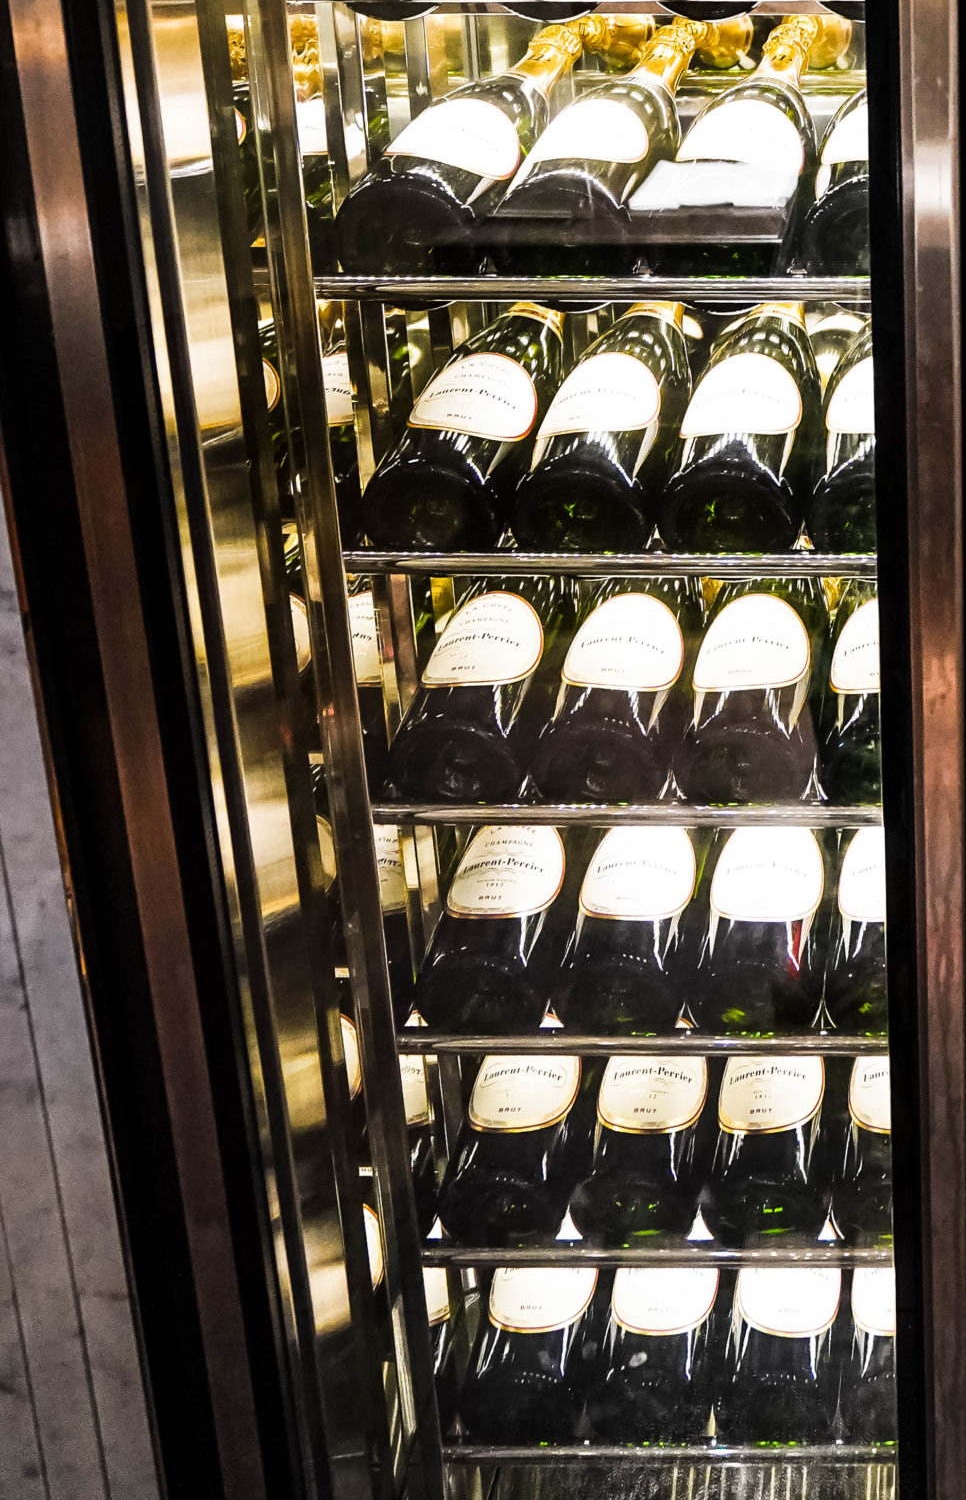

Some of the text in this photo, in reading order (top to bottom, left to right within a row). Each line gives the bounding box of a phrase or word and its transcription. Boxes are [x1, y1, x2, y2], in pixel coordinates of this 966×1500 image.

[438, 632, 521, 651] Laurent-Perrier
[484, 840, 534, 848] CHAMPAGNE
[463, 857, 544, 874] Laurent-Perrier
[484, 1065, 563, 1082] Laurent-Perrier
[613, 1066, 693, 1084] Laurent-Perrier
[729, 1065, 807, 1086] Laurent-Perrier
[749, 1107, 773, 1115] BRUT
